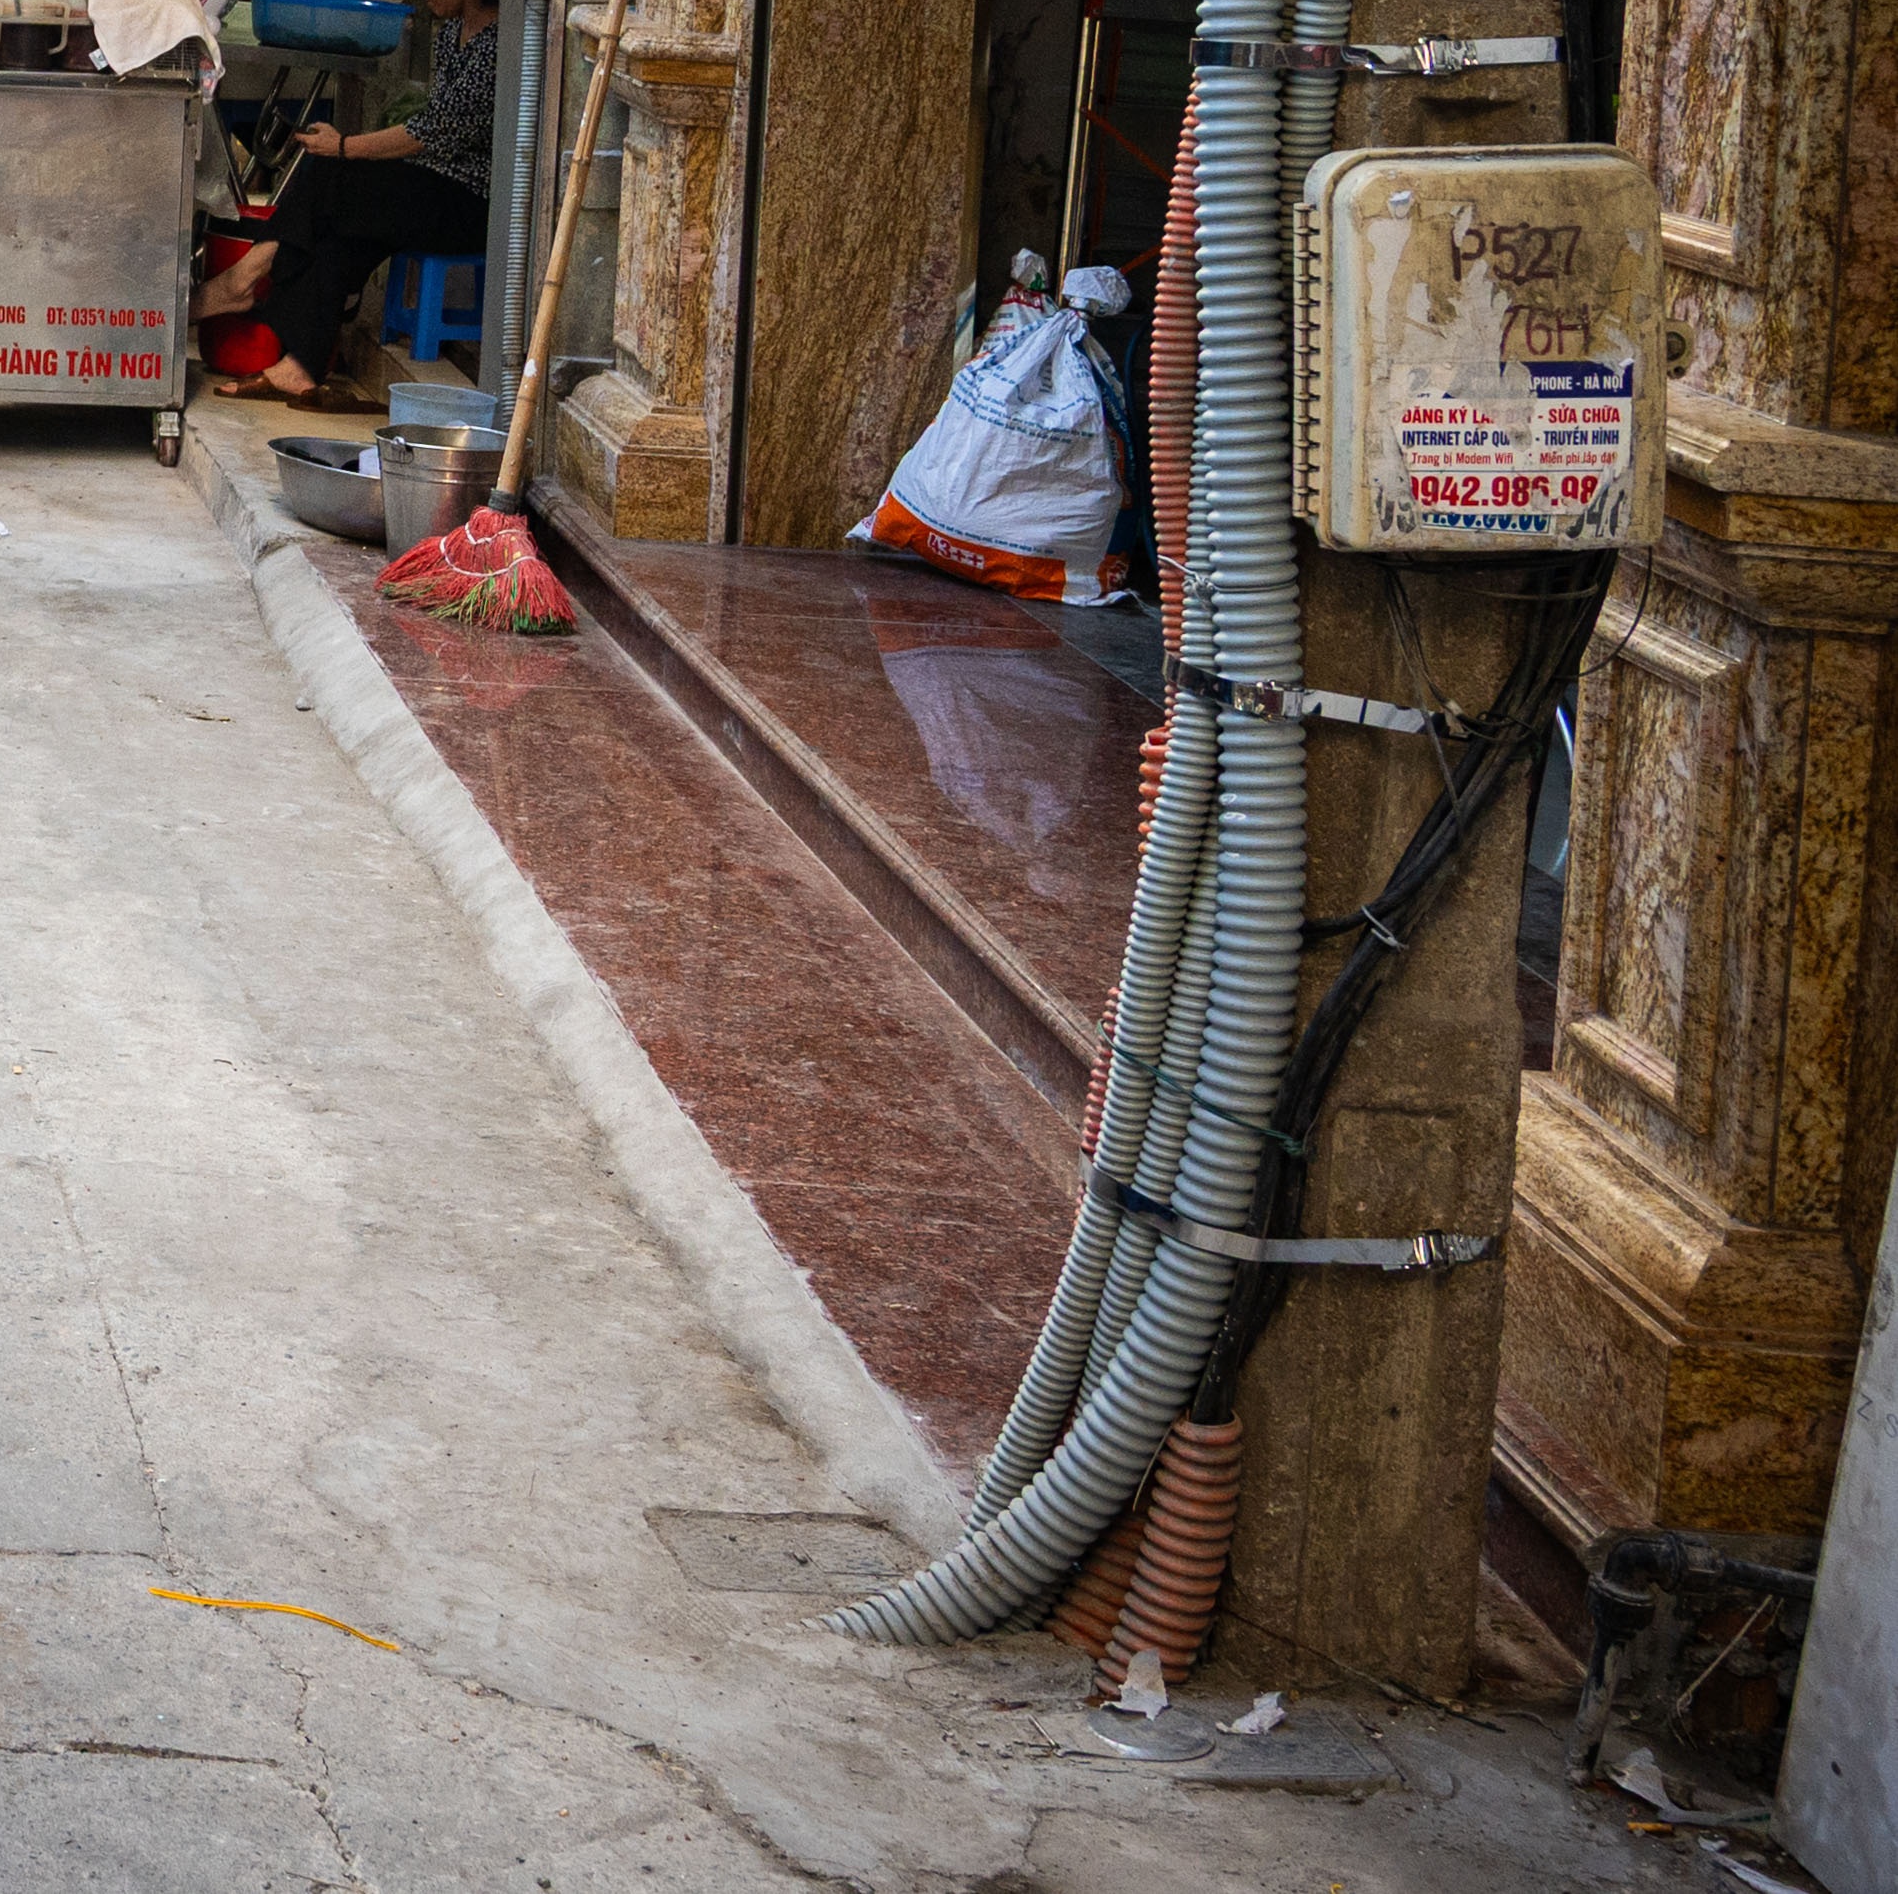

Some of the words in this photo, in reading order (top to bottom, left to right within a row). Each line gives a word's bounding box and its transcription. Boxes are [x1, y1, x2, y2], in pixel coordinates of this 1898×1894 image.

[65, 346, 112, 384] TẬN
[119, 353, 163, 380] NƠI
[1583, 373, 1600, 390] HÀ
[1448, 405, 1468, 424] KÝ
[1548, 403, 1578, 424] SỬA
[1582, 404, 1621, 424] CHỮA
[1402, 430, 1461, 447] INTERNET
[1464, 426, 1489, 447] CÁP
[1411, 452, 1440, 467] Trang
[1456, 452, 1491, 465] Modem
[1494, 452, 1514, 465] Wifi
